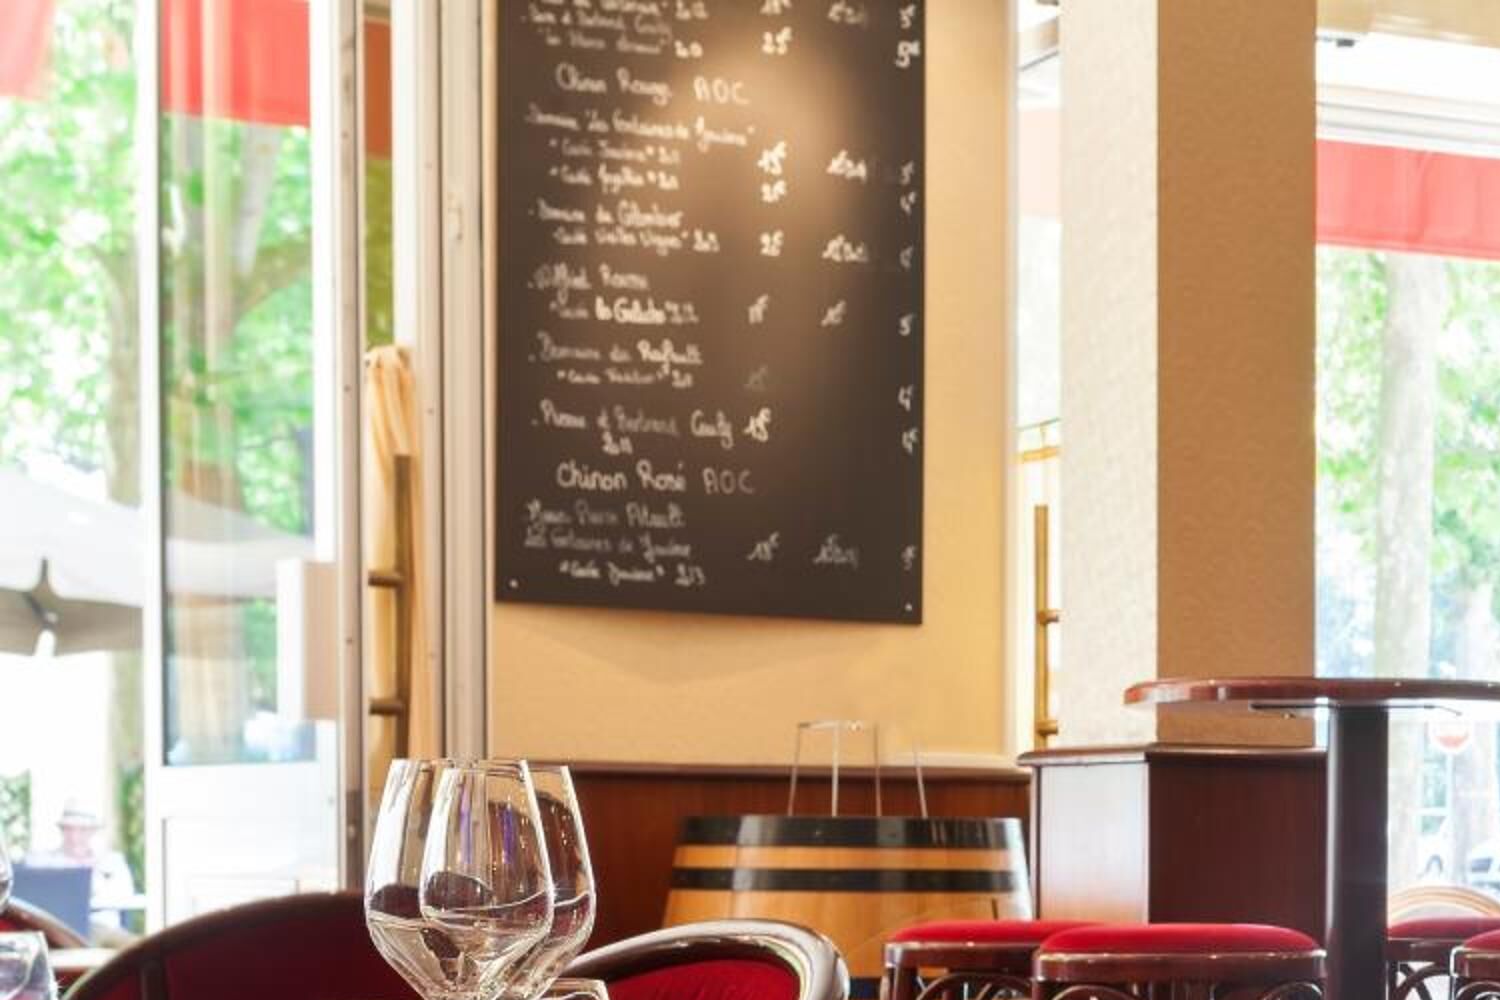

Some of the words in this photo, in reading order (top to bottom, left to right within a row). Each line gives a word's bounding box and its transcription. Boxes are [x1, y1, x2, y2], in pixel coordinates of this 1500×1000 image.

[693, 76, 748, 105] AOC
[556, 459, 628, 491] Chinon
[635, 458, 686, 491] Rosé
[702, 467, 755, 495] AOC
